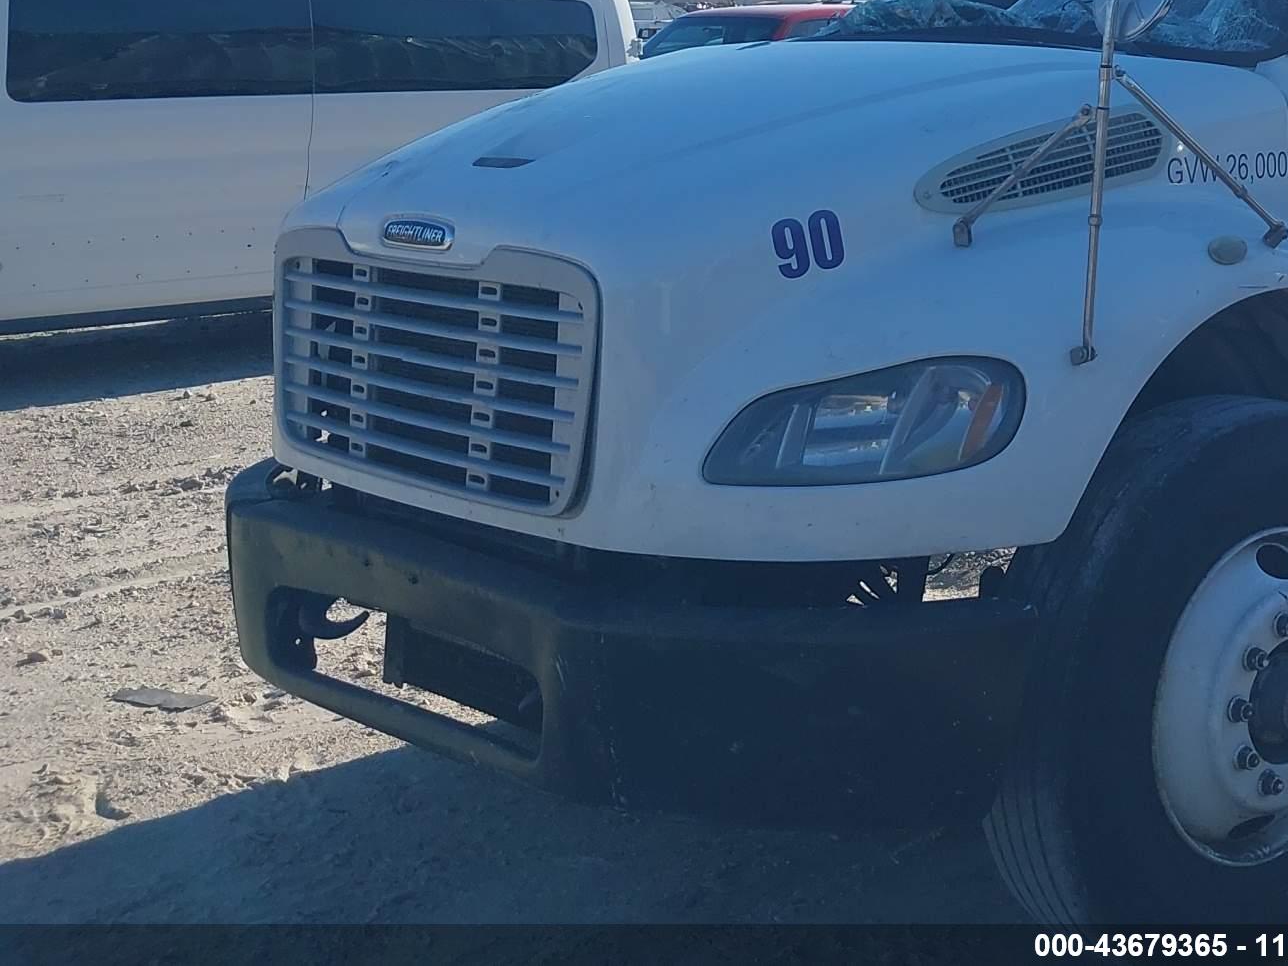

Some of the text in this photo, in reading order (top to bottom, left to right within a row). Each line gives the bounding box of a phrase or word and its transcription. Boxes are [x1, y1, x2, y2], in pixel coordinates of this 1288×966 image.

[1226, 150, 1288, 185] 26,000
[387, 224, 445, 243] FREIGHTLINER
[772, 210, 844, 278] 90
